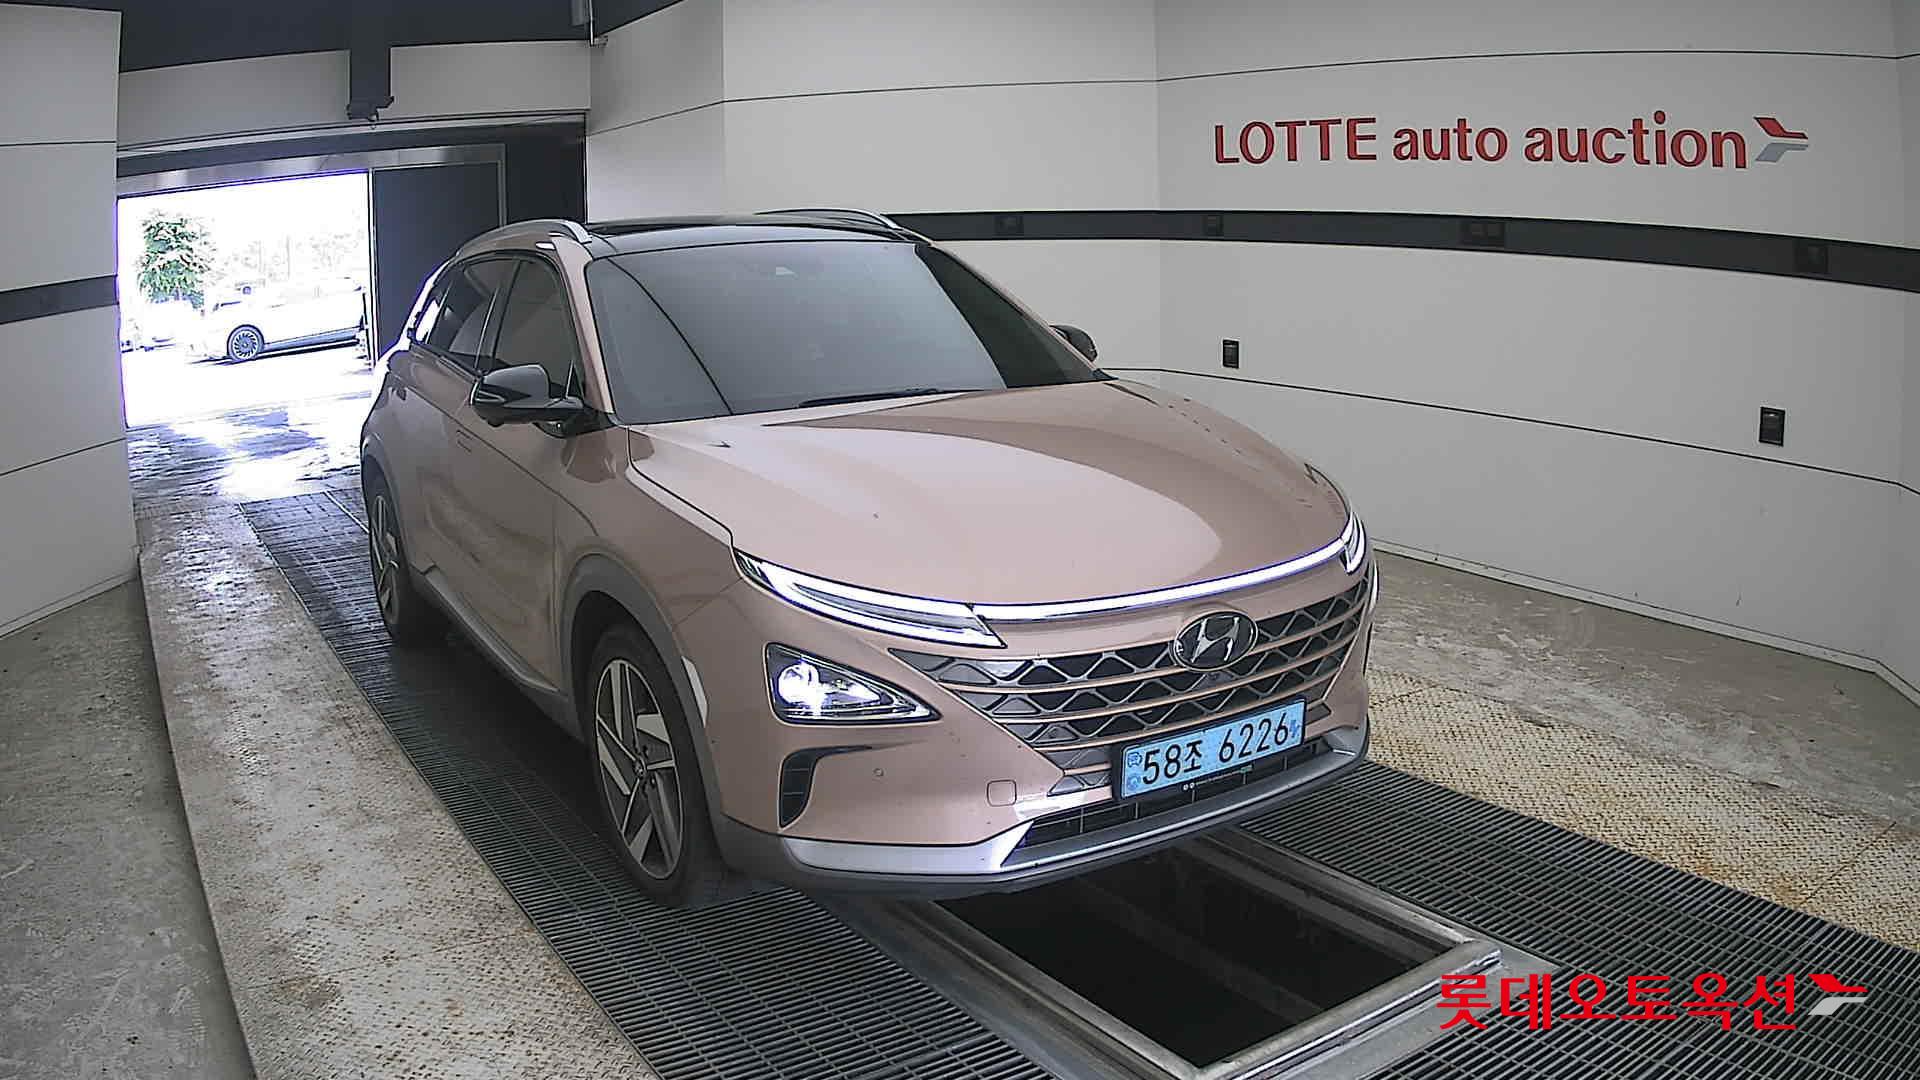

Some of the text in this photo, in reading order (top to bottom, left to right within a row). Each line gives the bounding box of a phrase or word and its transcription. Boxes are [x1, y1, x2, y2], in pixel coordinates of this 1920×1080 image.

[1214, 111, 1747, 169] LOTTE auto auction
[1142, 739, 1203, 785] 58조
[1218, 711, 1289, 763] 6226
